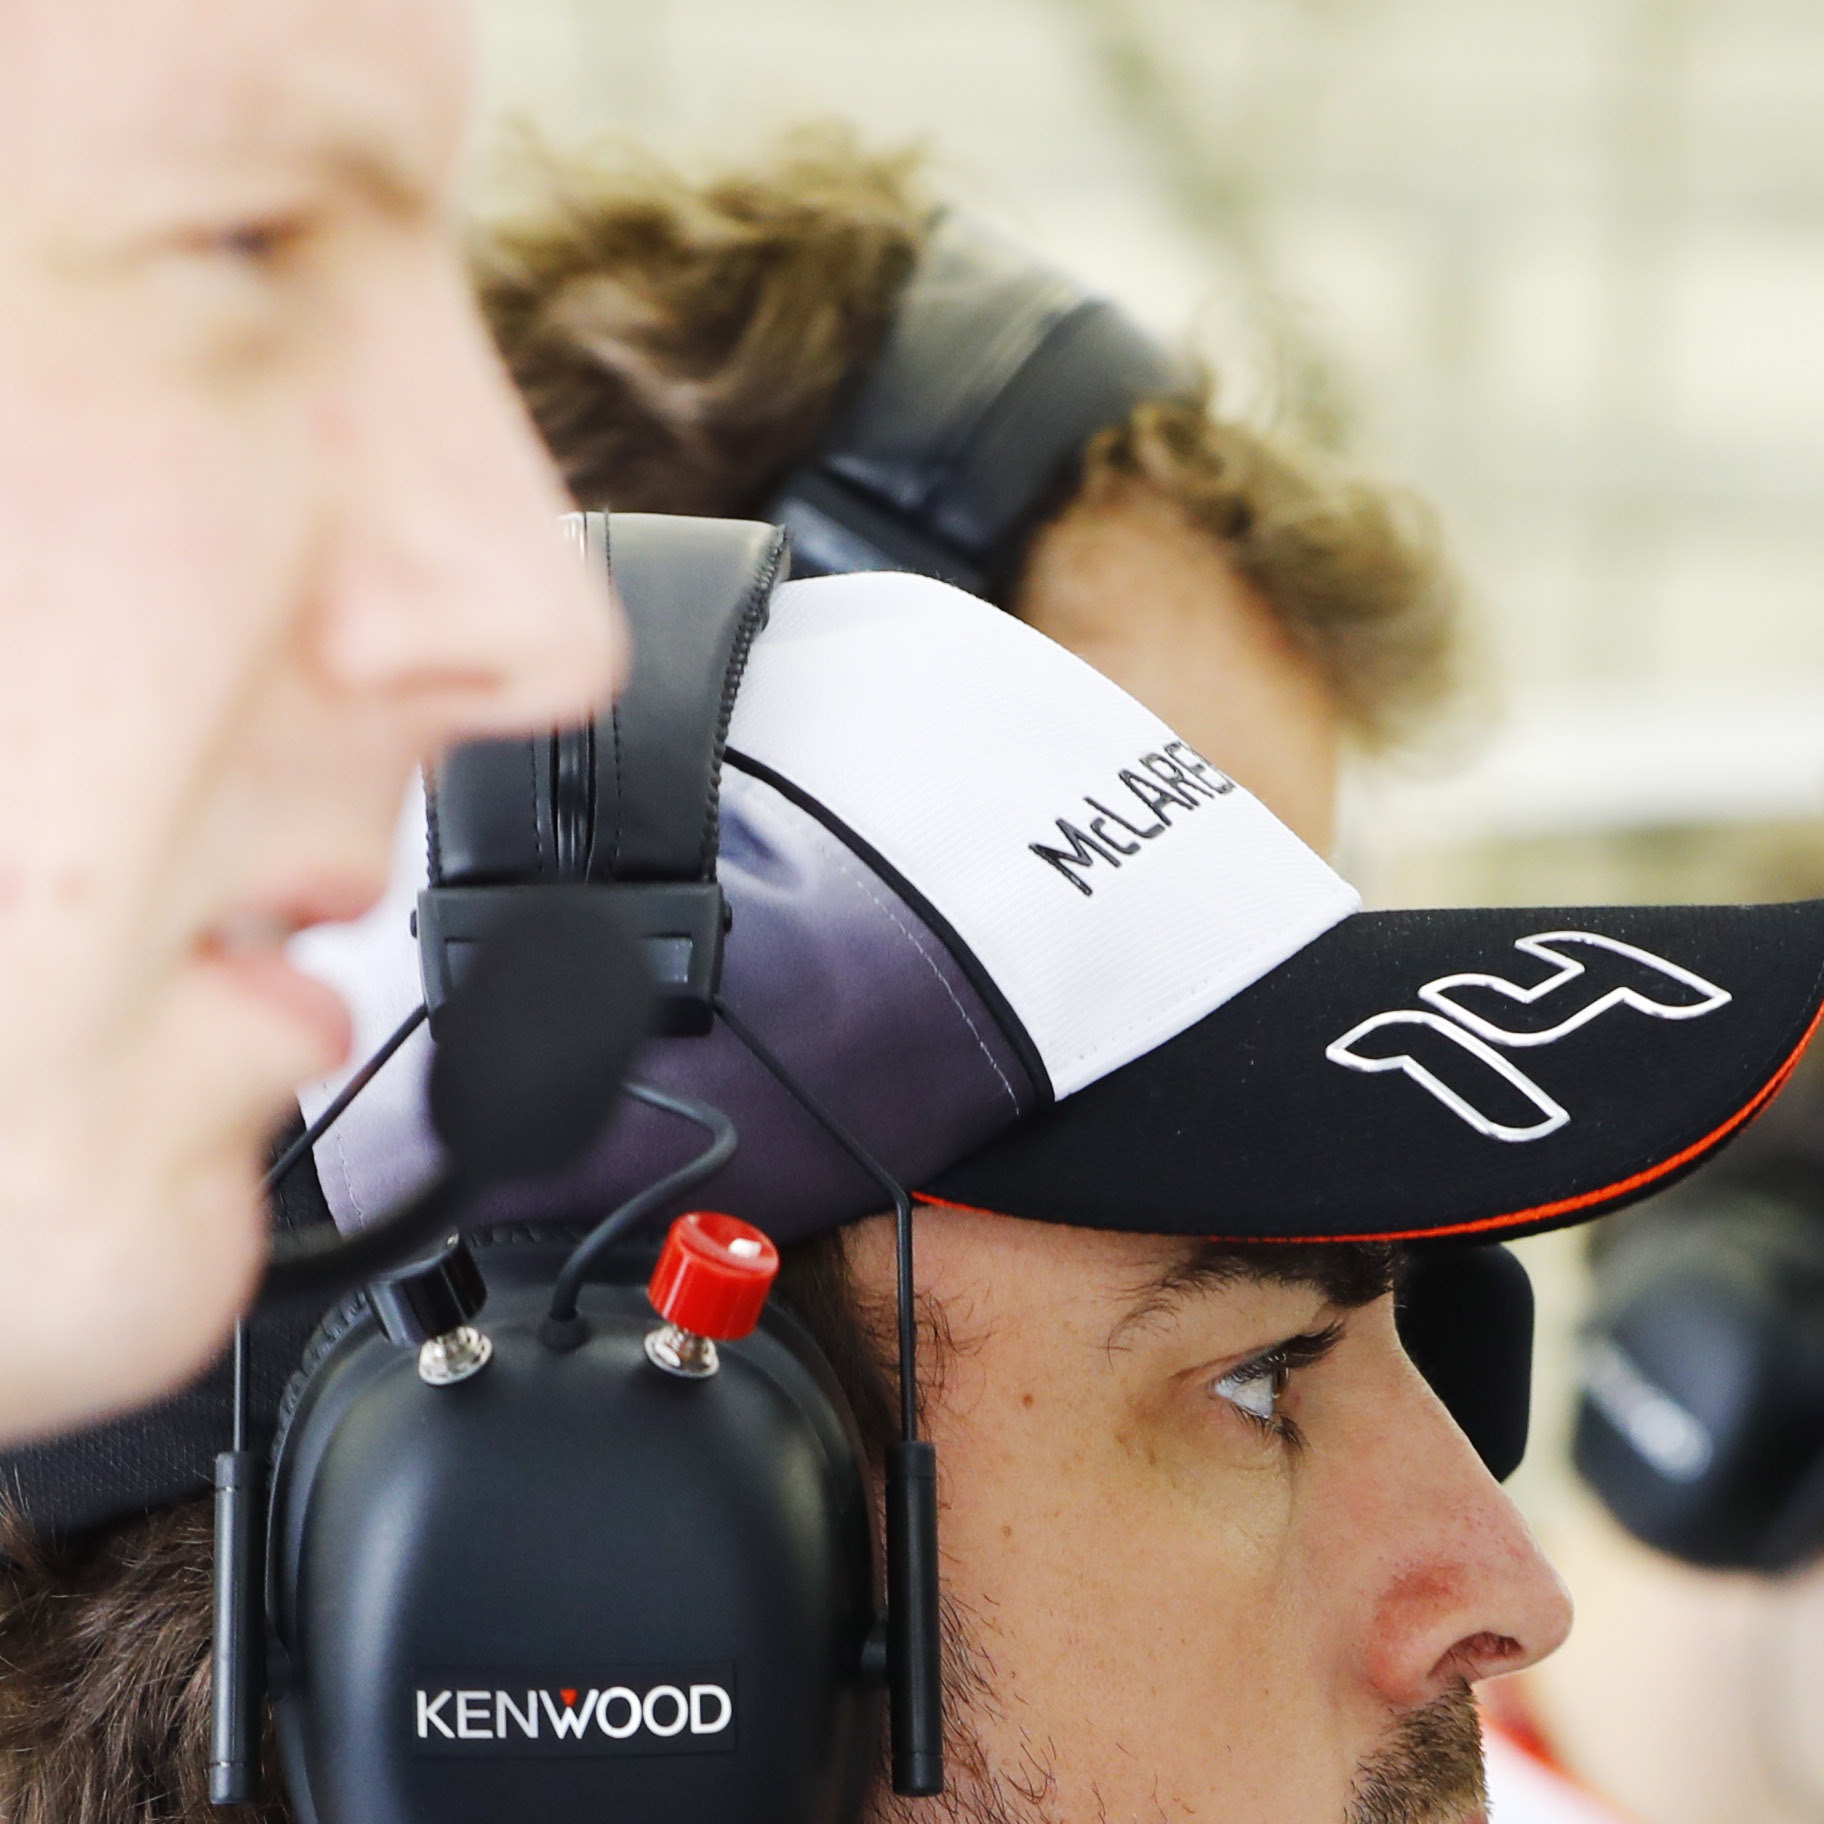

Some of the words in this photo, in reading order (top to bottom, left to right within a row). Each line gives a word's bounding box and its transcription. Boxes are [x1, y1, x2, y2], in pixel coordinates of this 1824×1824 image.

[1027, 740, 1236, 897] McLARE
[1325, 930, 1733, 1142] 14
[416, 1684, 733, 1740] KENWOOD
